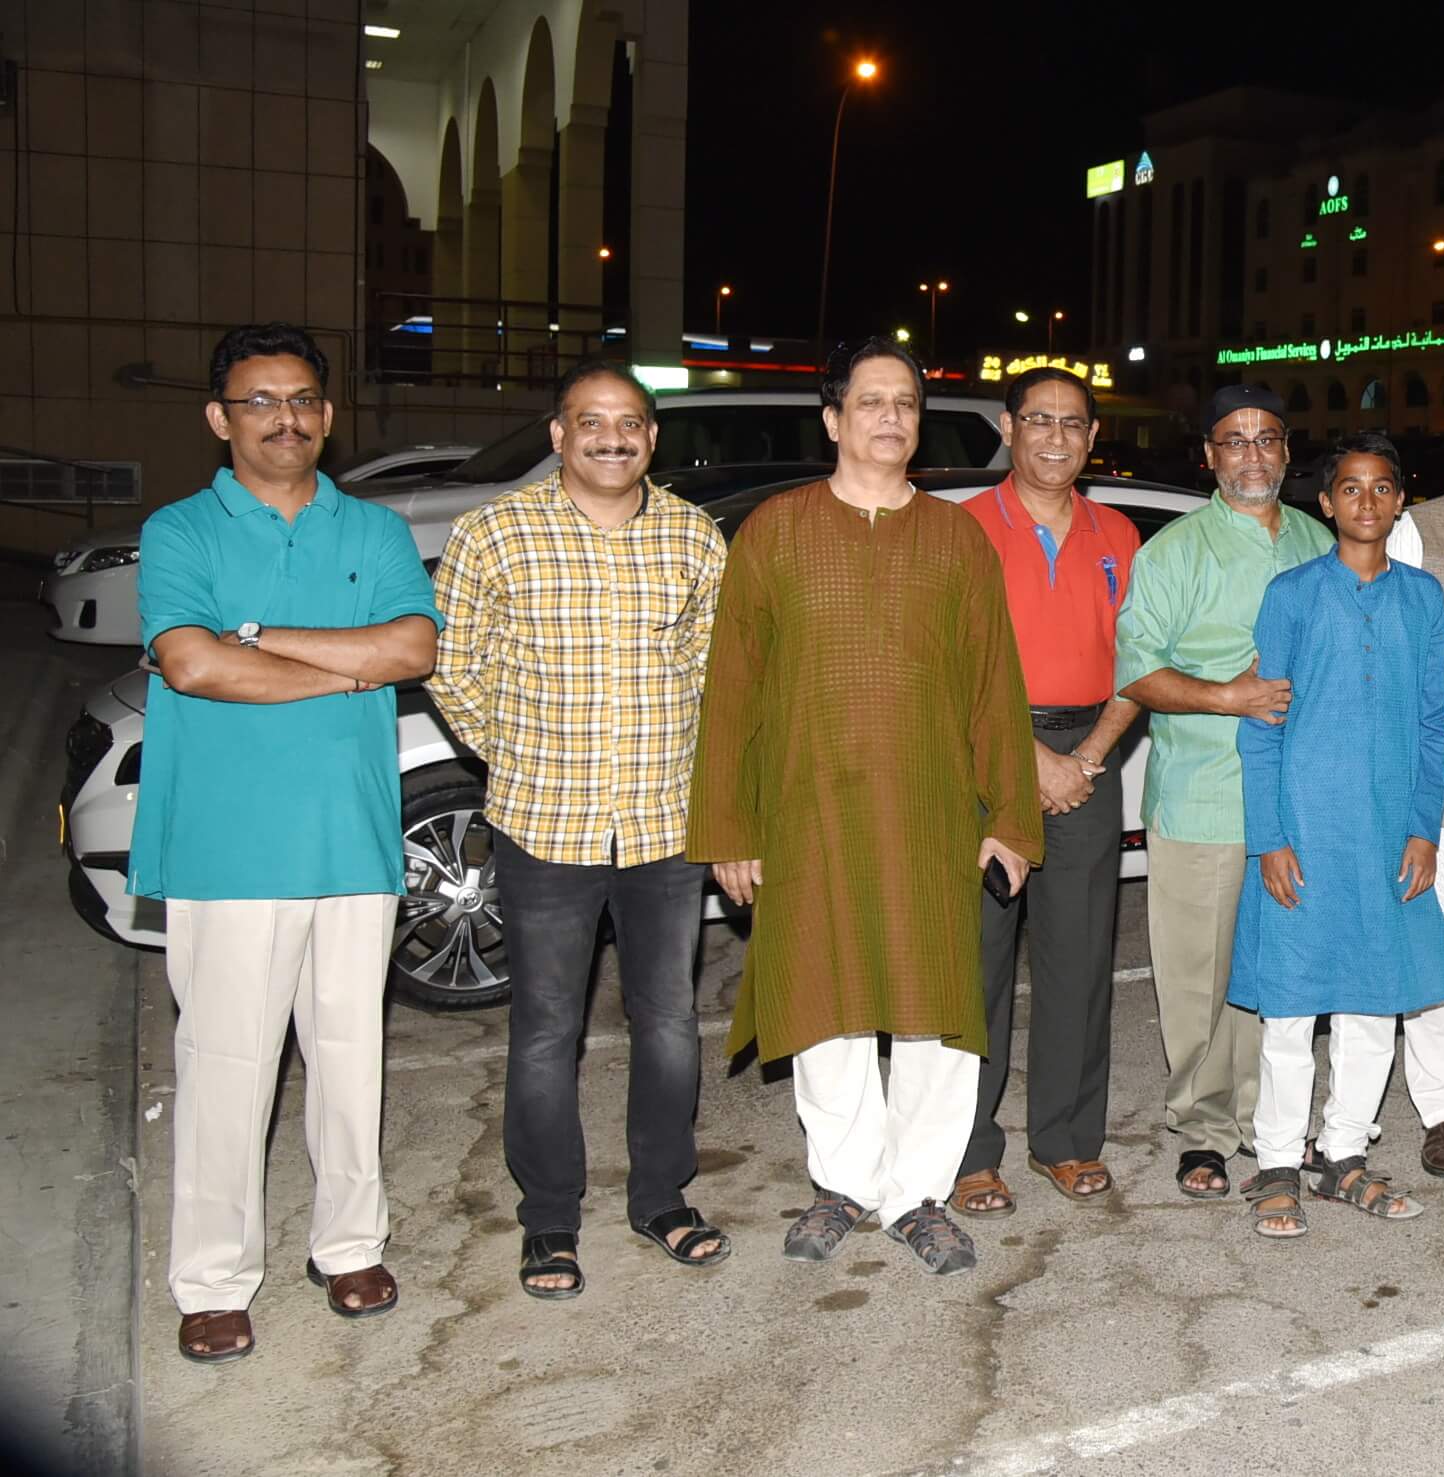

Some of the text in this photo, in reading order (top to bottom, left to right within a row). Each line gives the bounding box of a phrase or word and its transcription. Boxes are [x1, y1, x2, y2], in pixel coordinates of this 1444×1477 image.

[1319, 196, 1348, 215] AOFS
[1217, 349, 1226, 364] Al
[1256, 345, 1287, 362] Financial
[1288, 342, 1317, 359] Services
